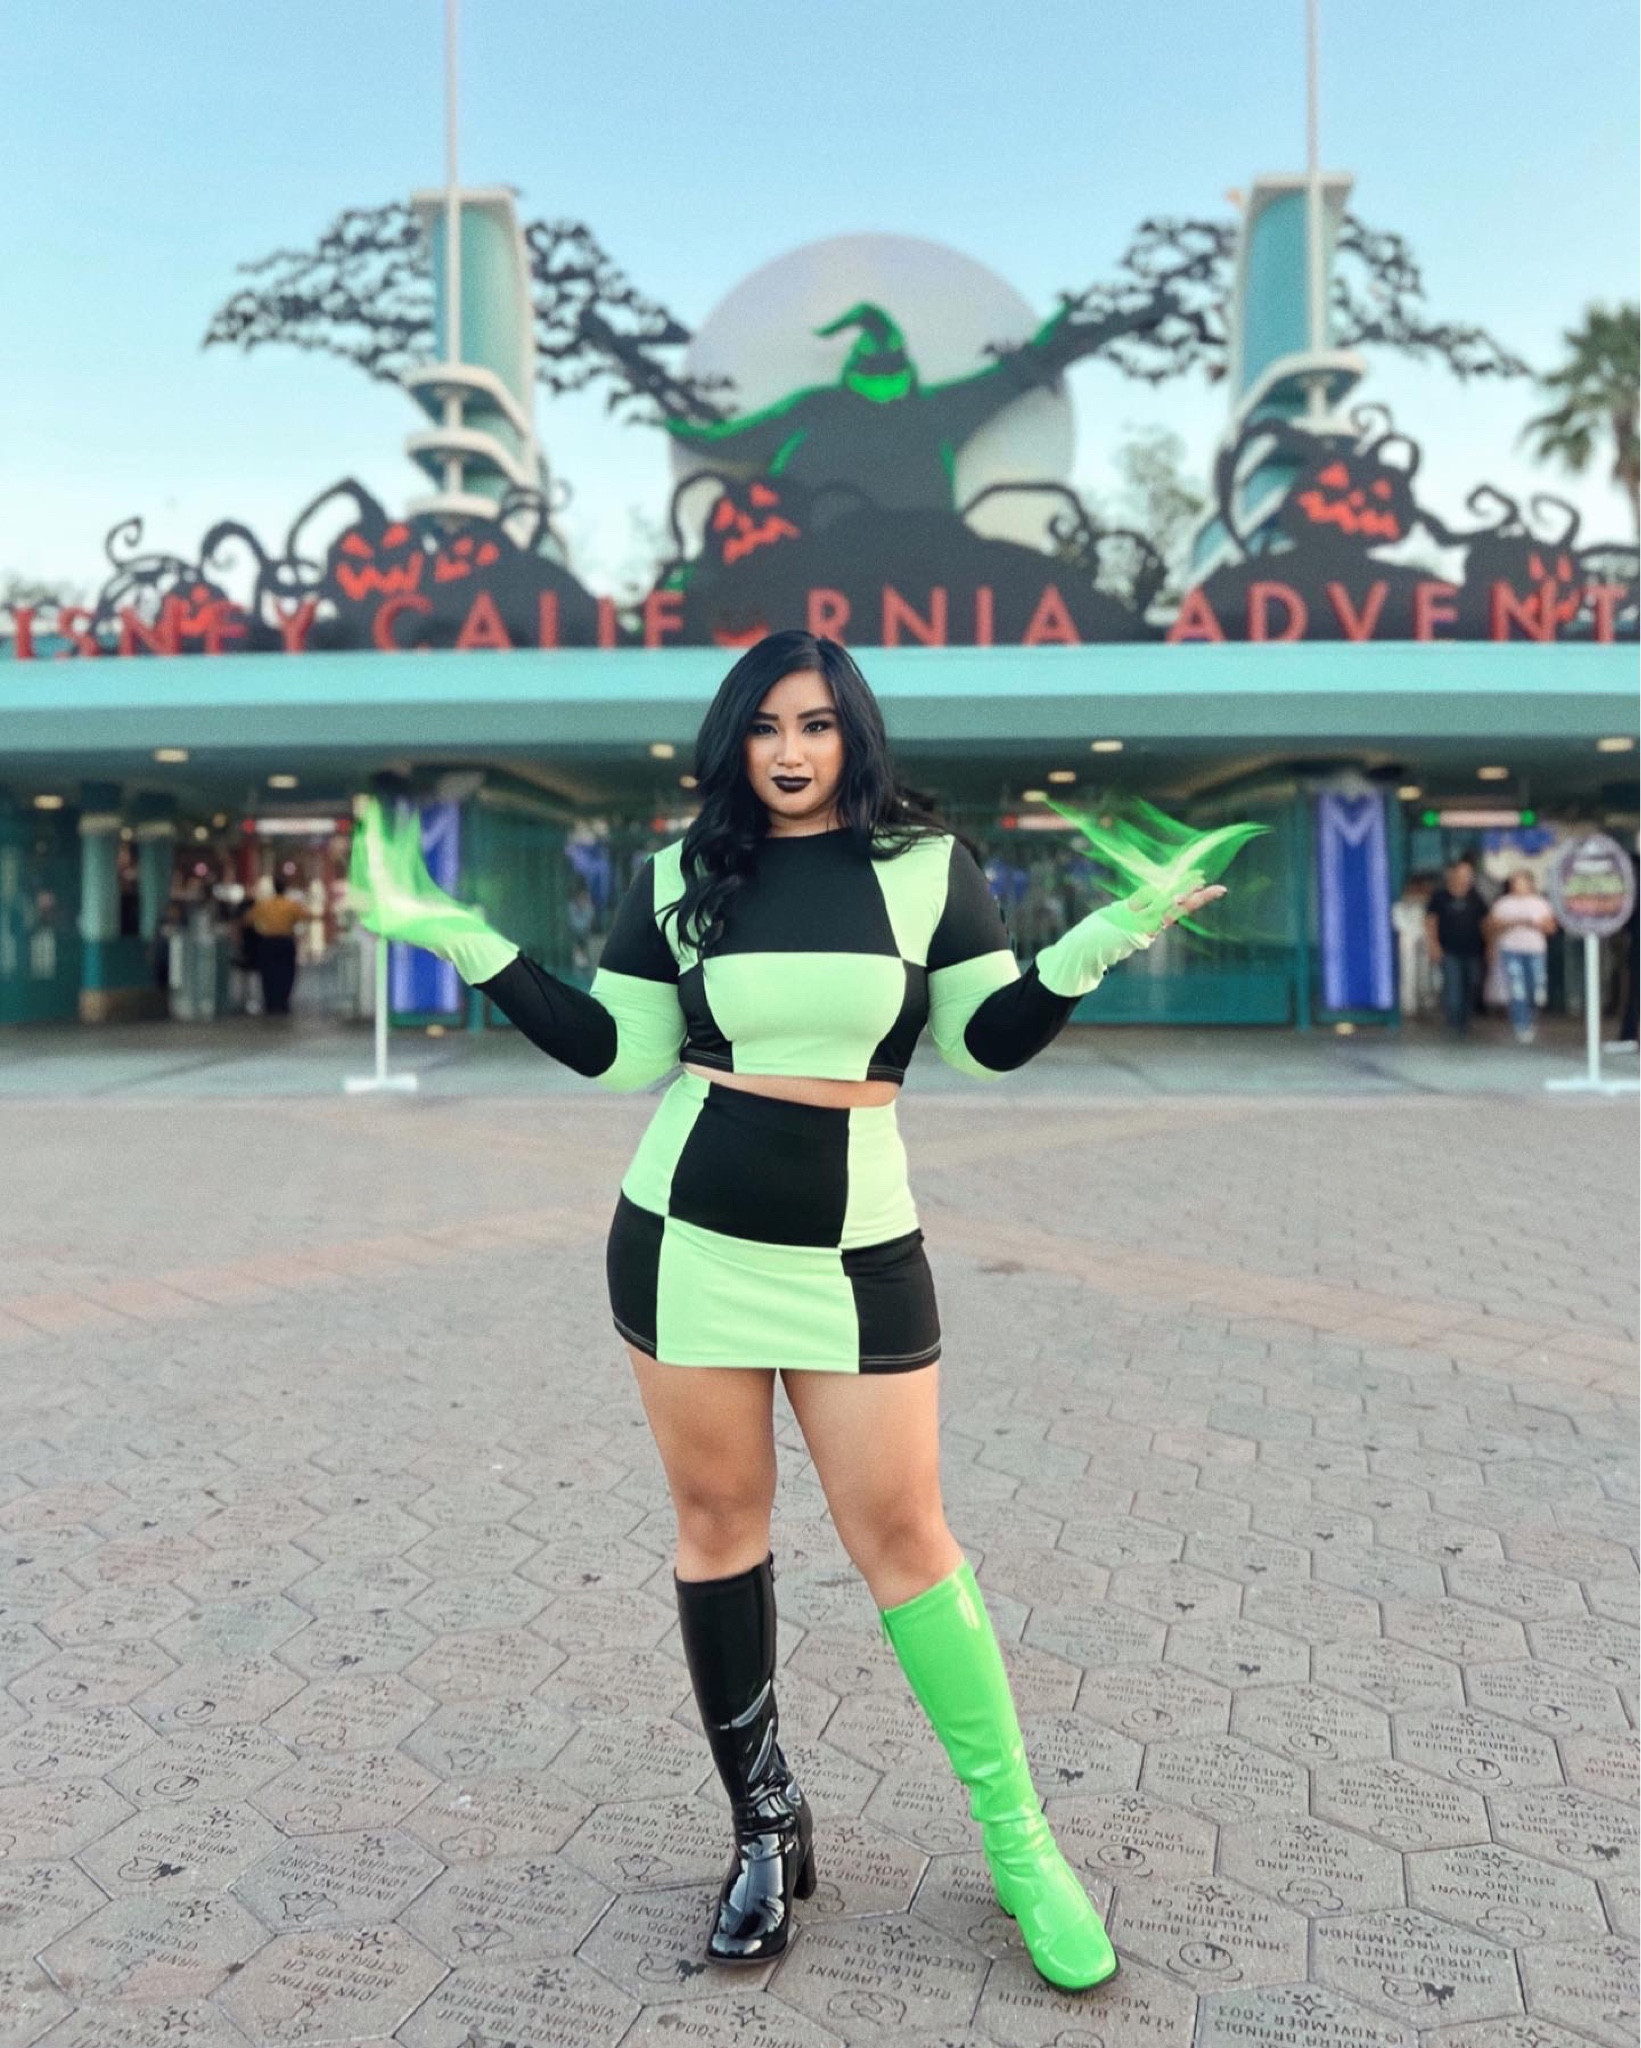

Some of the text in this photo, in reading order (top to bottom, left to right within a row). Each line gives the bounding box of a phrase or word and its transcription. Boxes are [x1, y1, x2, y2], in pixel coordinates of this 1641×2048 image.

[371, 584, 1082, 653] CALIFRNIA
[910, 1983, 952, 2001] RICK
[1213, 2019, 1297, 2045] BRANDIS
[1273, 2013, 1378, 2041] NOVEMBER
